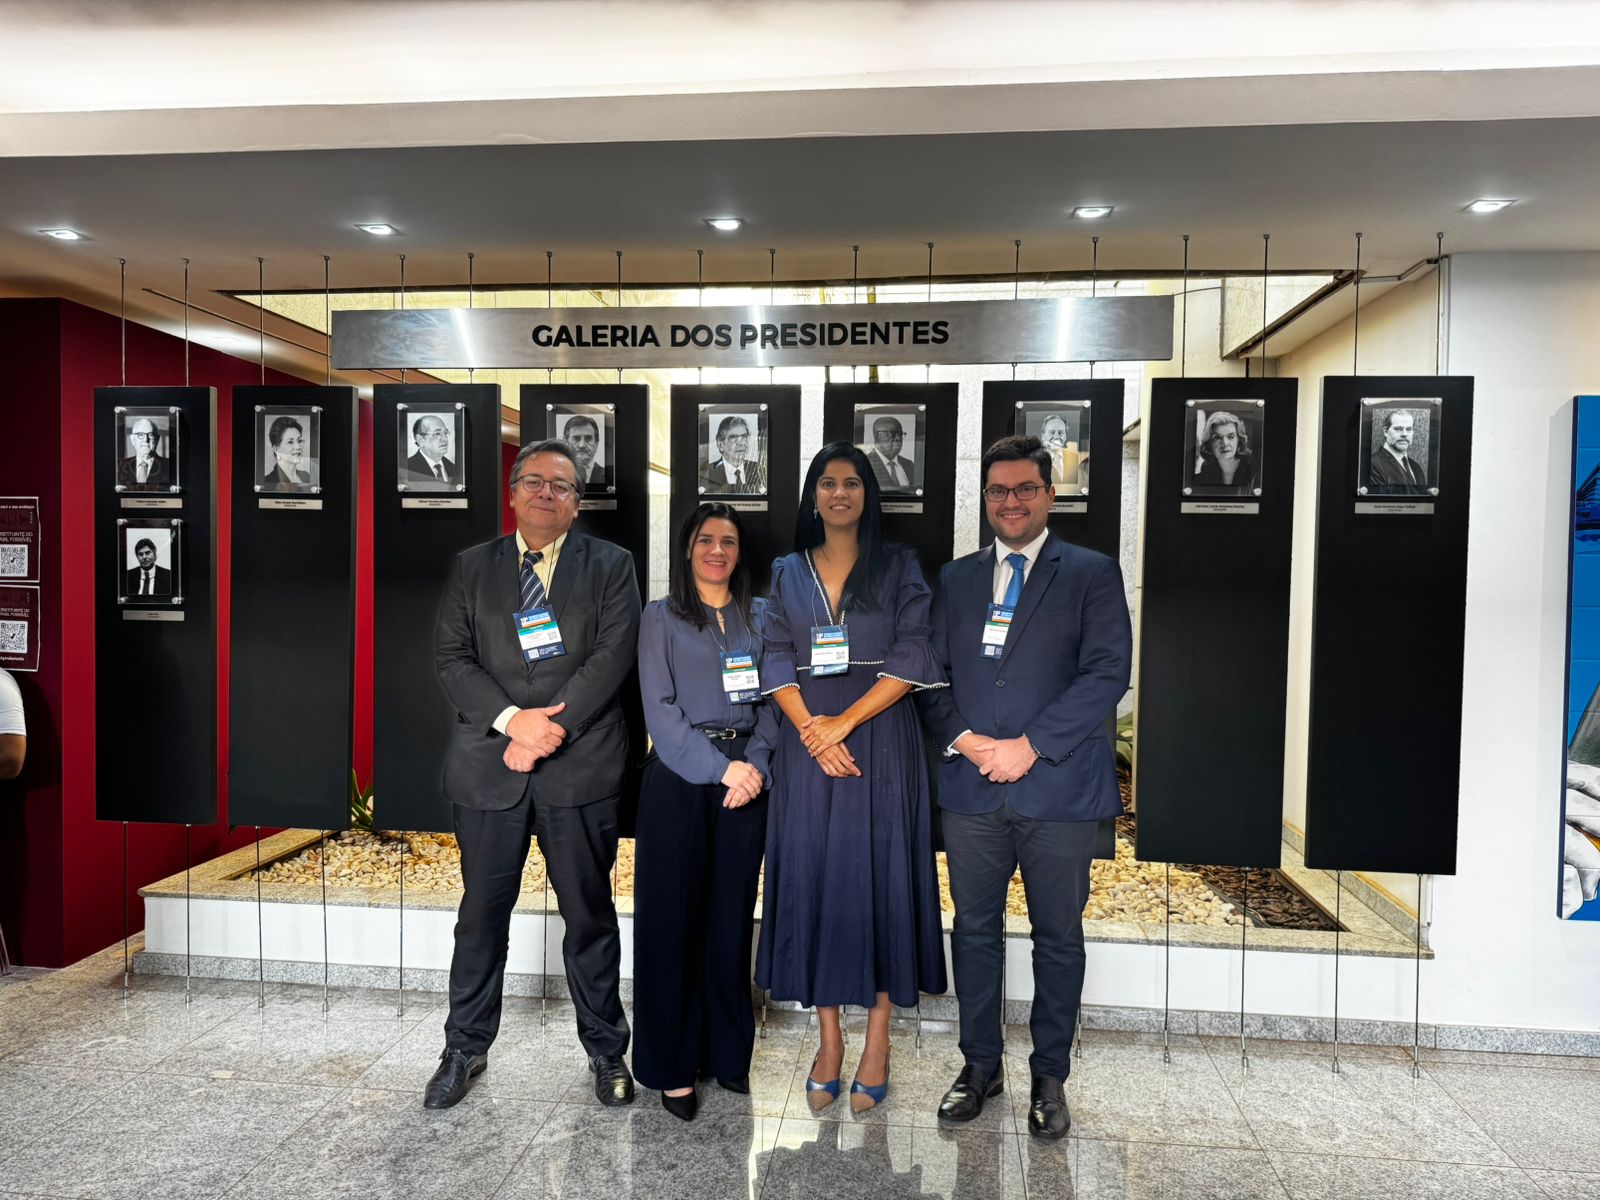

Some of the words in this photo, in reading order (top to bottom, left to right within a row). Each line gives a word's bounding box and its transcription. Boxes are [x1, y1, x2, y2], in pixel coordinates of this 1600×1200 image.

[532, 324, 660, 347] GALERIA
[670, 324, 732, 348] DOS
[740, 320, 950, 348] PRESIDENTES
